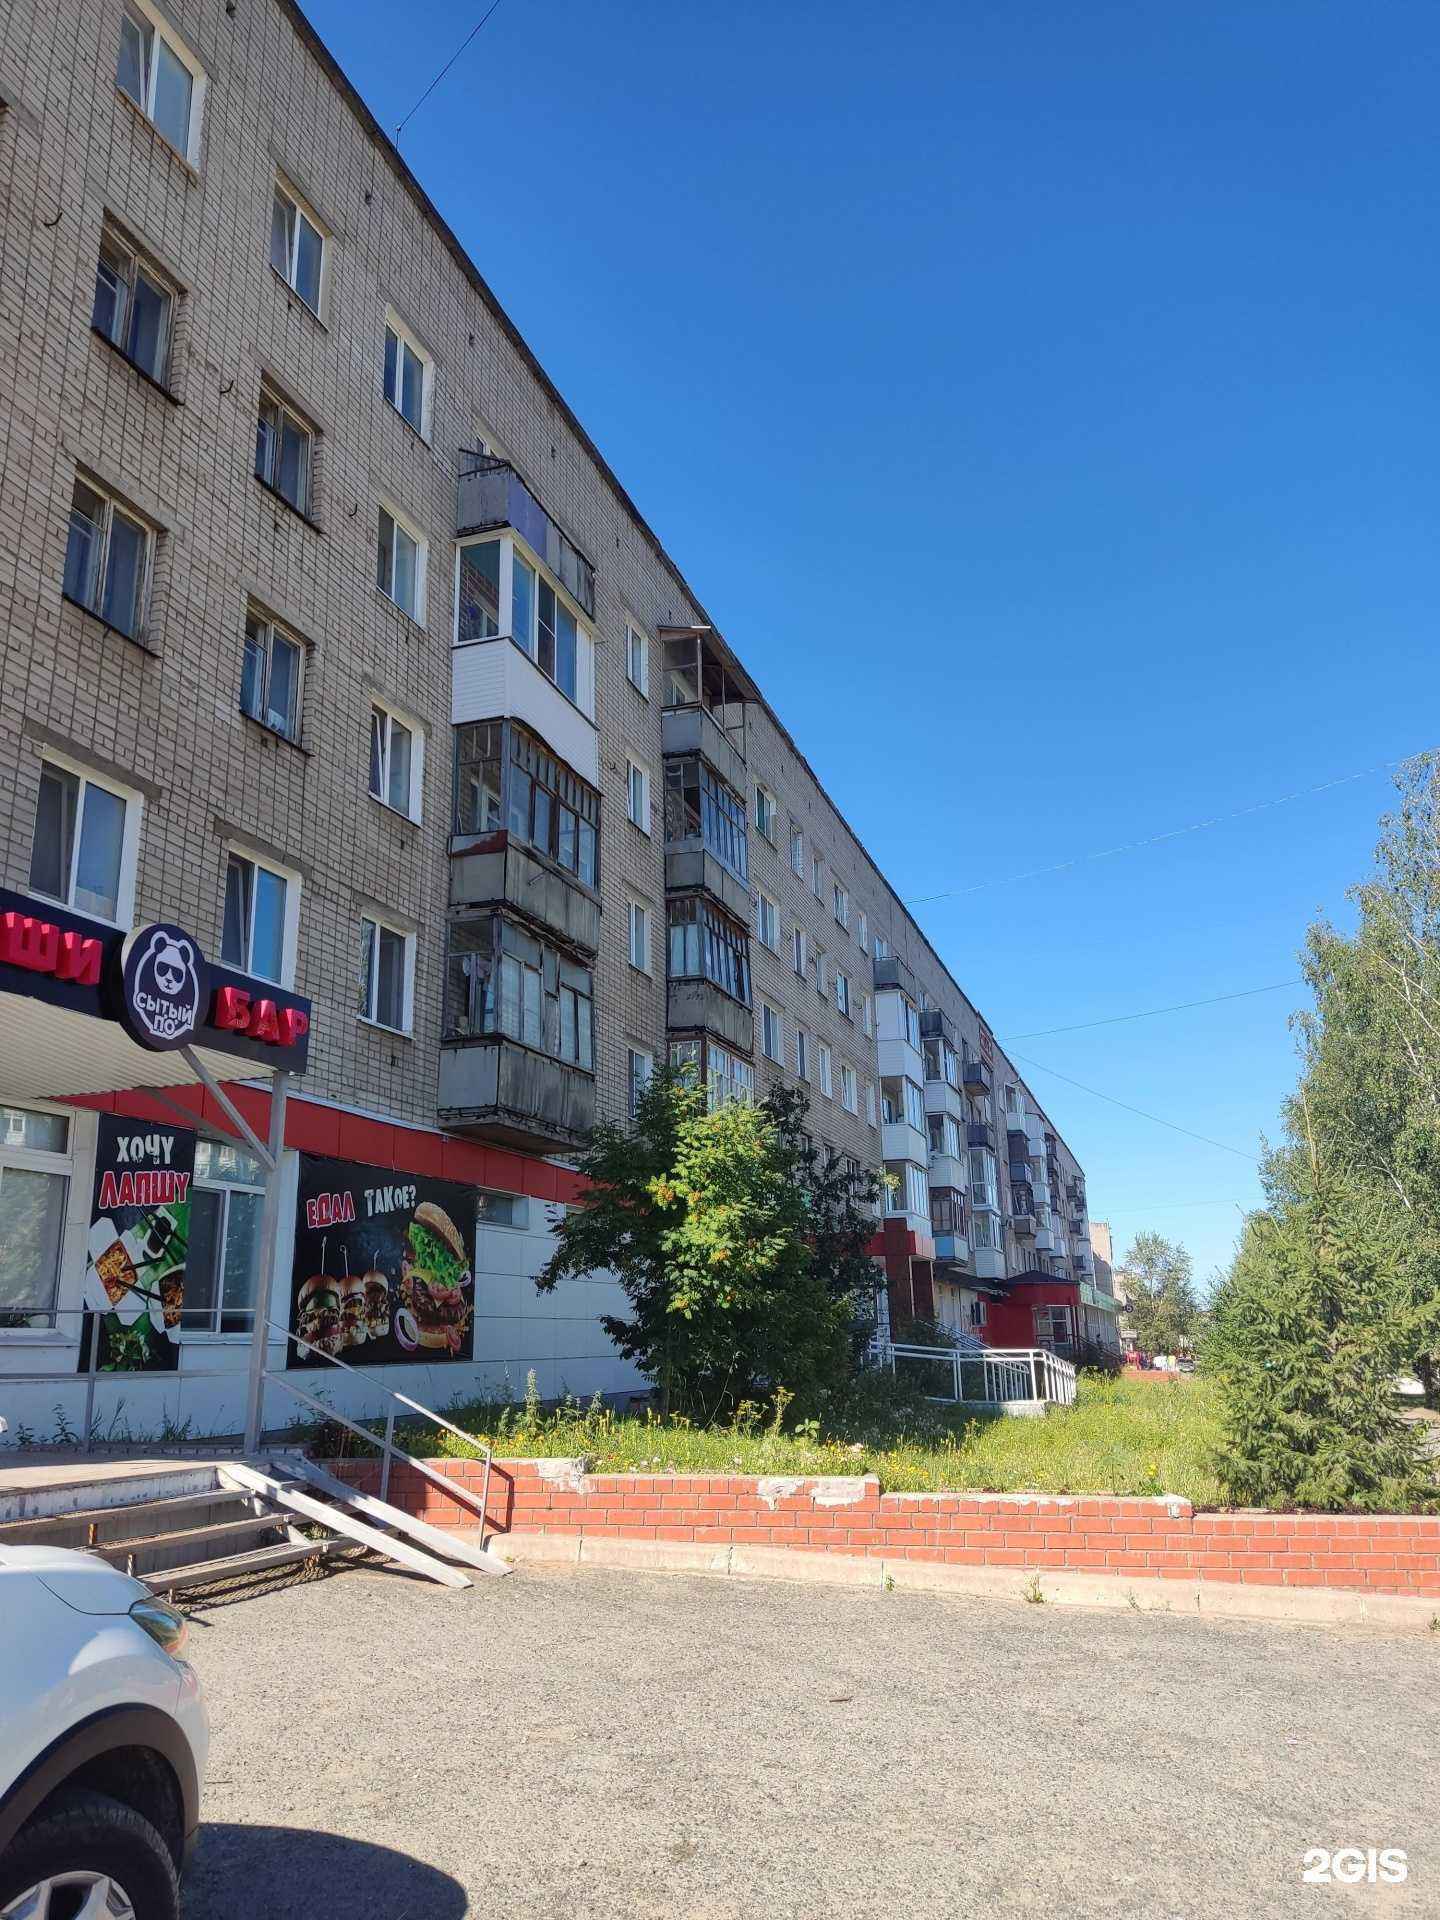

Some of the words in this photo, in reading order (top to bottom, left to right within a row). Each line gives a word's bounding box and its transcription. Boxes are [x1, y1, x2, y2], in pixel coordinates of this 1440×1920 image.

[137, 992, 192, 1024] СЫТЫЙ
[216, 986, 309, 1046] БАР
[116, 1133, 175, 1165] ХОЧУ
[99, 1170, 190, 1209] ЛАПШУ
[306, 1191, 356, 1229] ЕДАЛ
[364, 1185, 417, 1217] ТАКОЕ?
